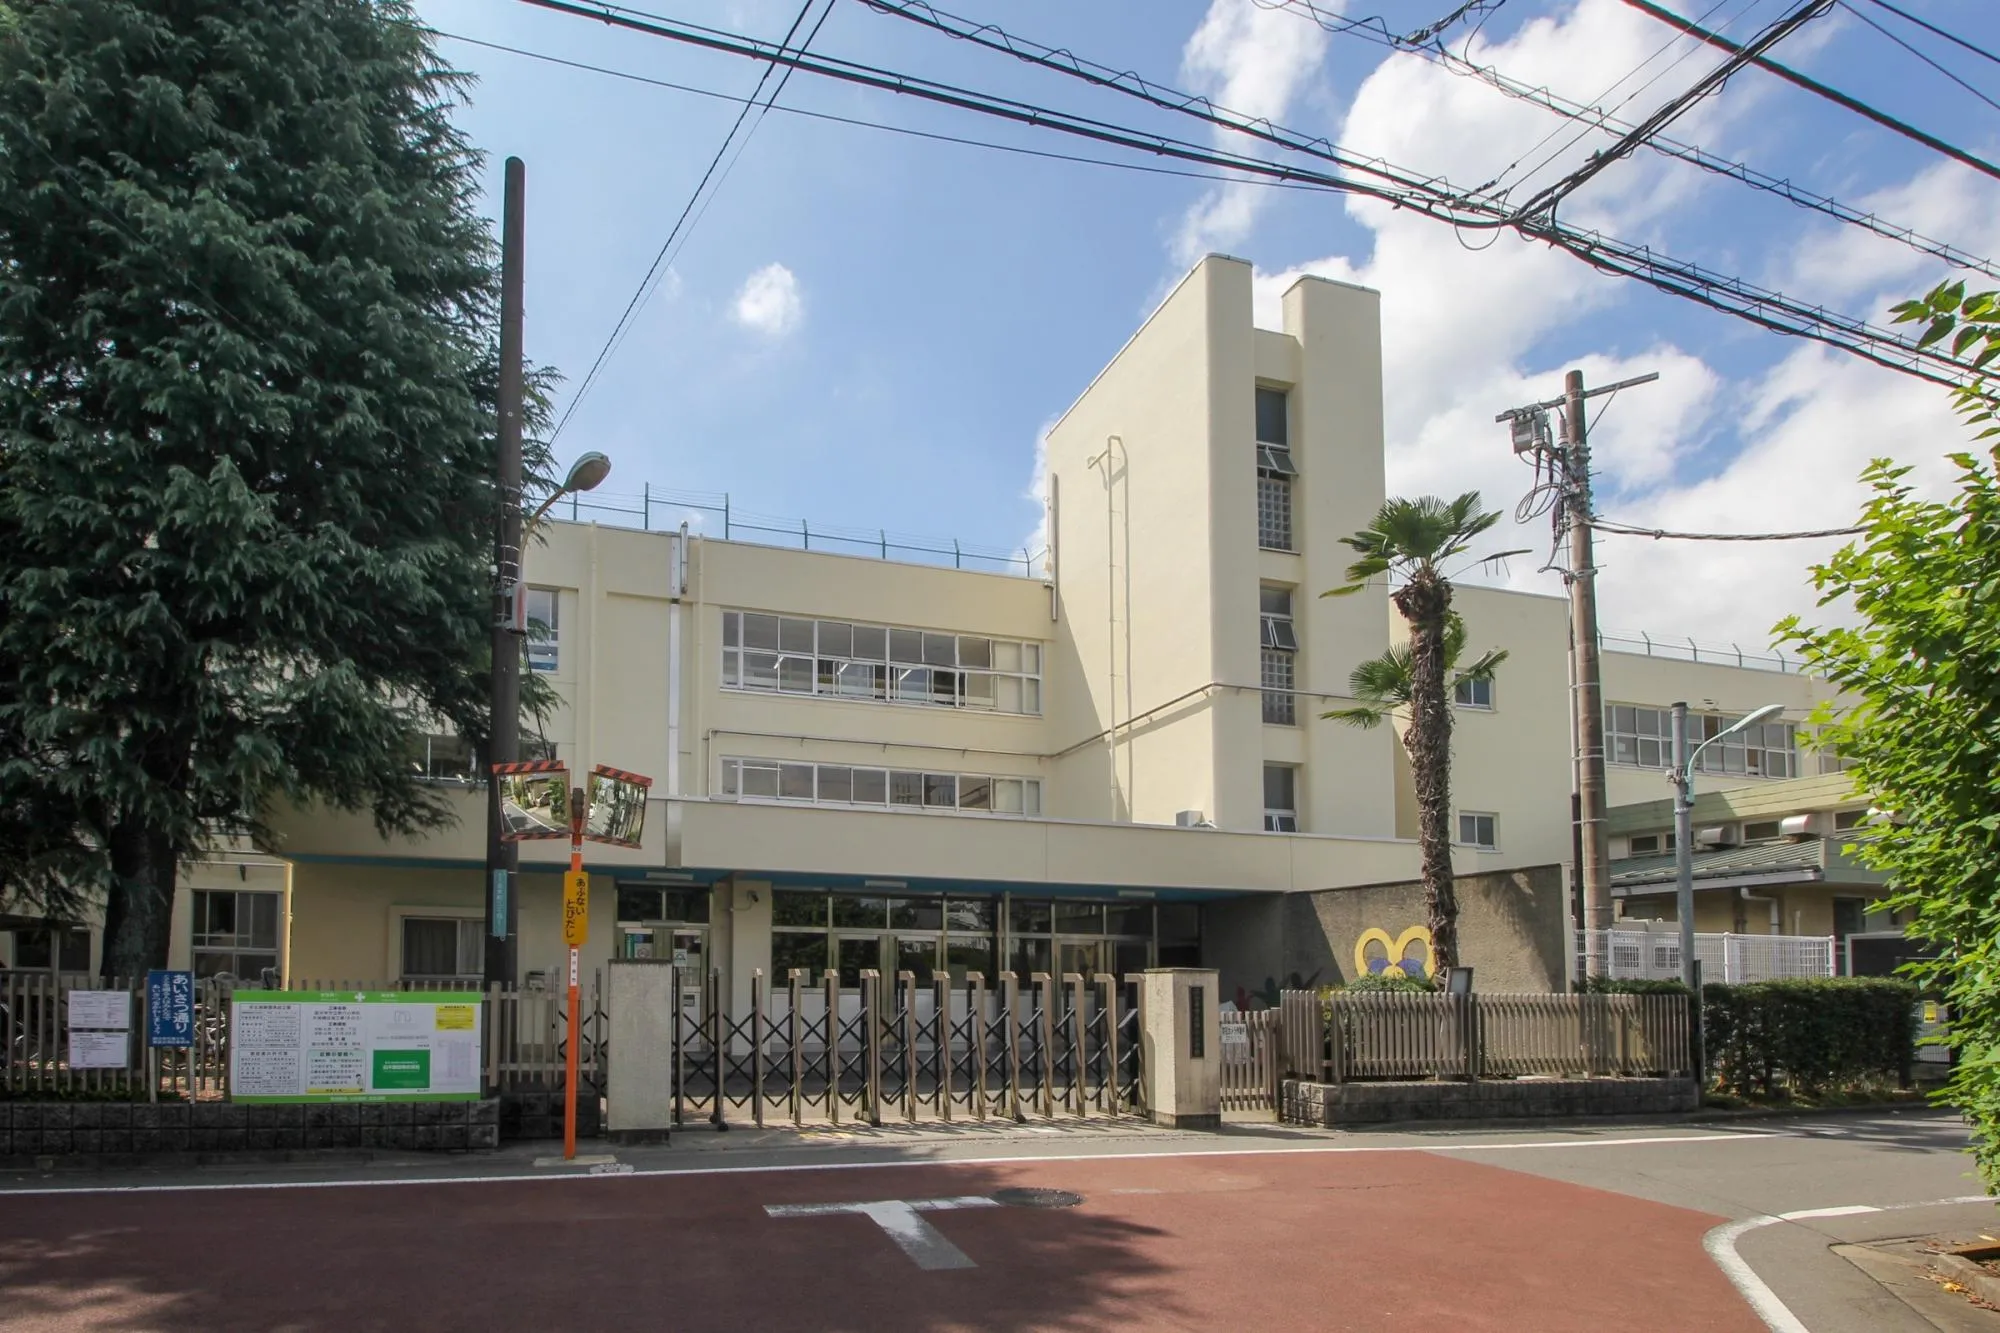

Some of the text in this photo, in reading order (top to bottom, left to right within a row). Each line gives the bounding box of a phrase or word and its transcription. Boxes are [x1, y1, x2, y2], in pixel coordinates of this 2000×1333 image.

[576, 878, 586, 915] あぶない
[566, 899, 576, 938] とびだし
[173, 974, 190, 1034] あいさつ通り
